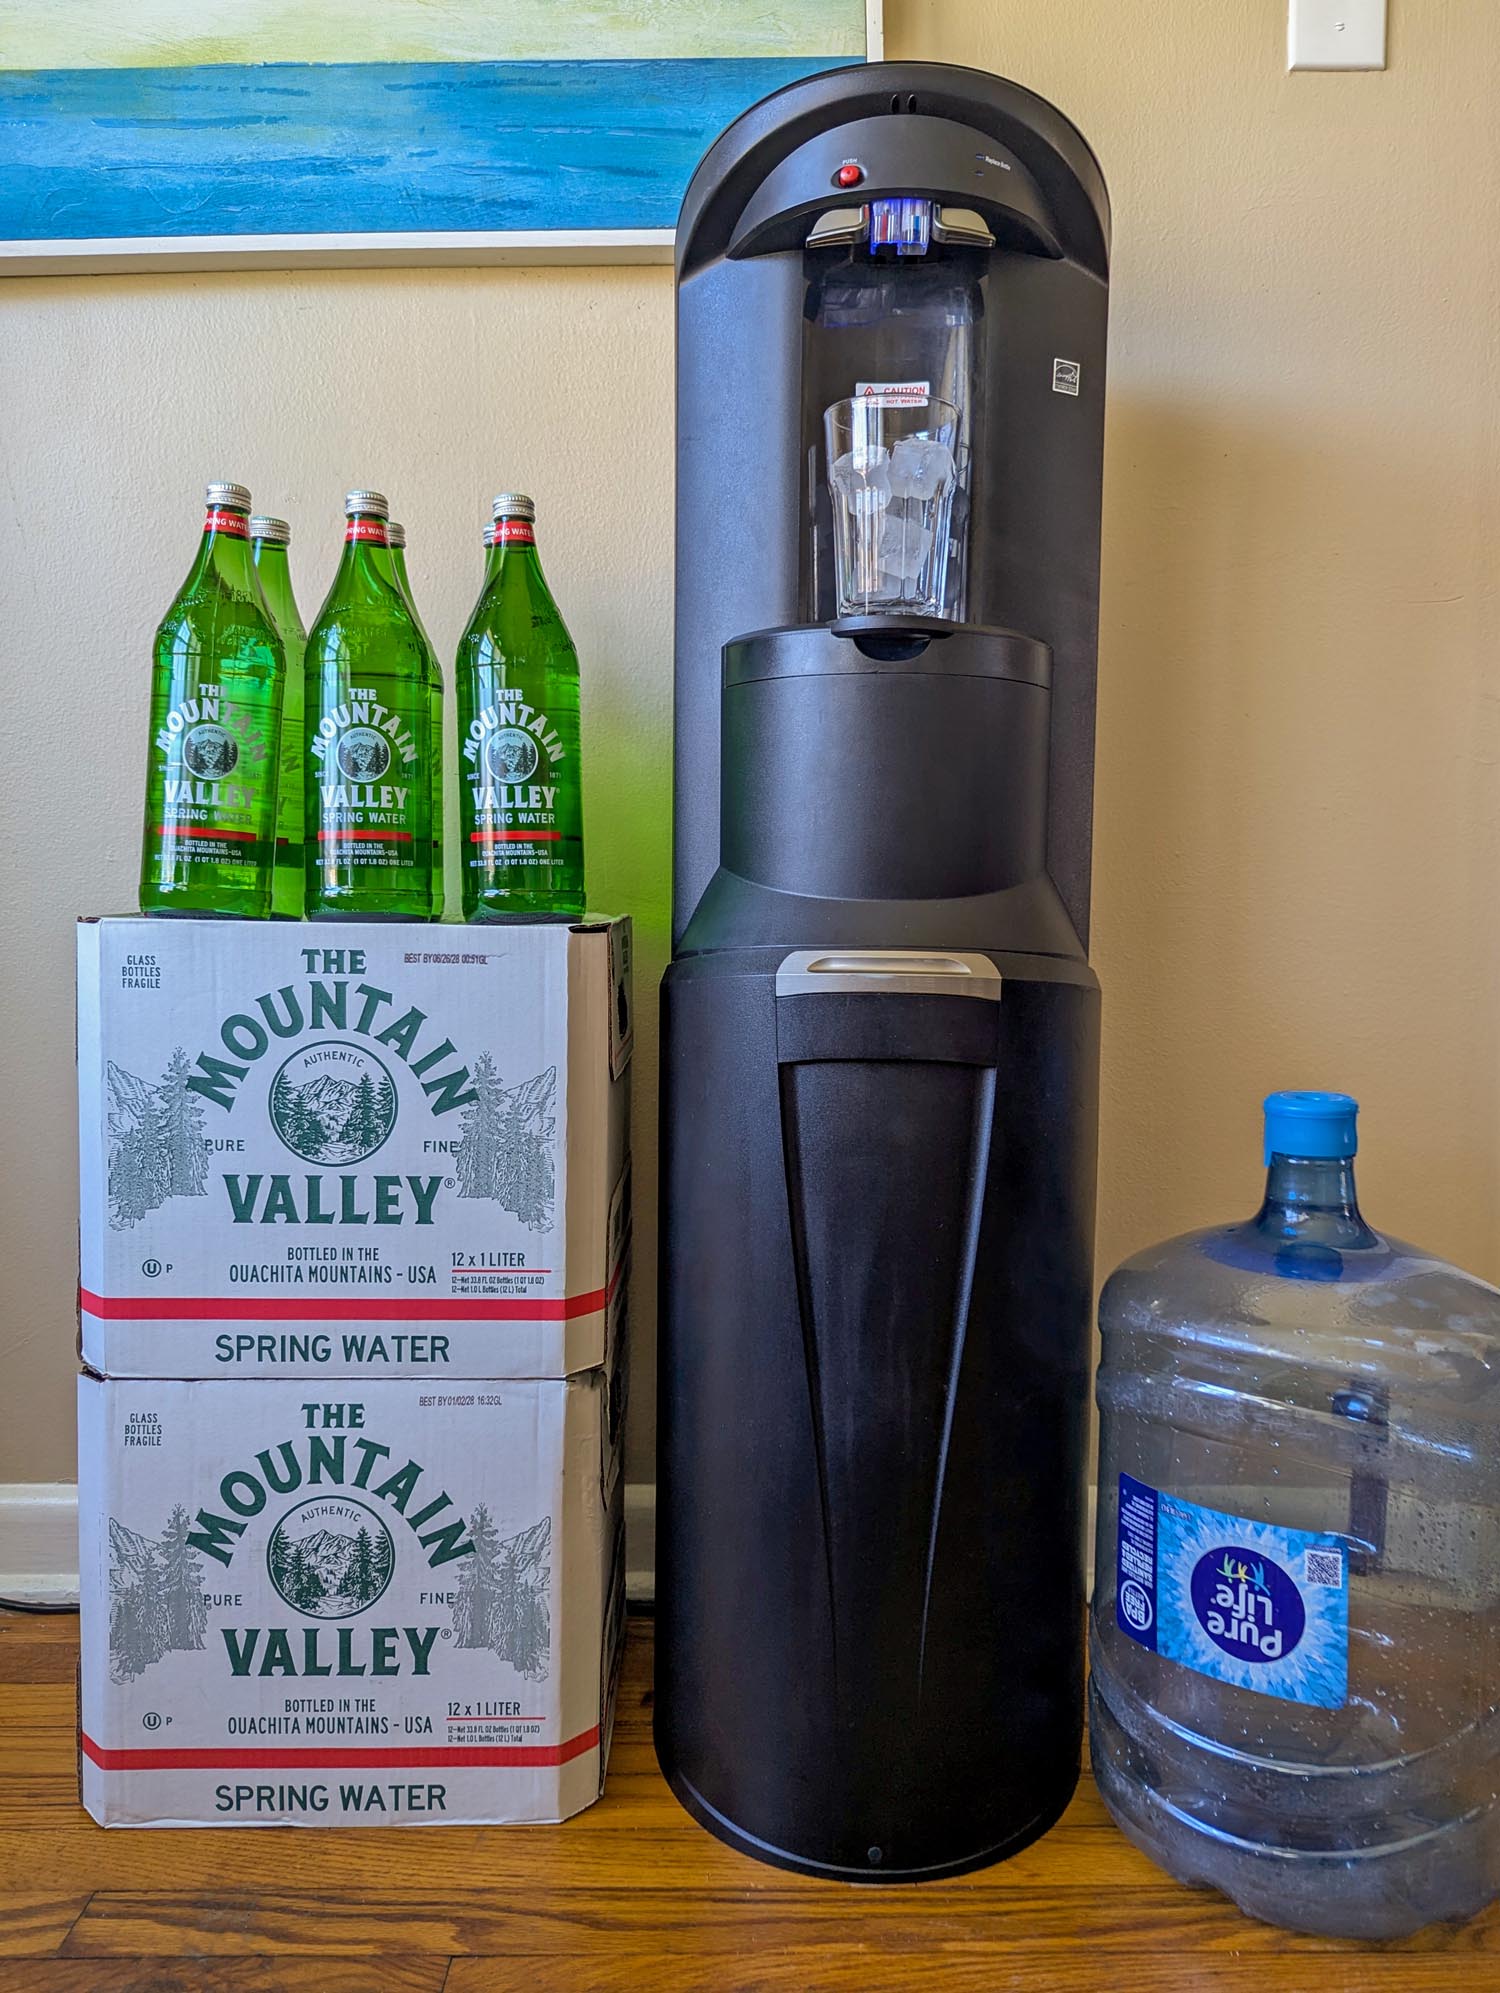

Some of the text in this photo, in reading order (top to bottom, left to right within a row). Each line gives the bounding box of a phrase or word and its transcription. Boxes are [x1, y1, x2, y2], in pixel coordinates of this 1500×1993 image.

[884, 386, 926, 395] CAUTION
[229, 519, 248, 530] WATE
[368, 528, 387, 537] WATE
[512, 528, 534, 537] WATE
[349, 688, 377, 700] THE
[496, 689, 523, 701] THE
[156, 697, 268, 762] MOUNTAIN
[311, 702, 418, 764] MOUNTAIN
[463, 703, 566, 763] MOUNTAIN
[164, 780, 256, 808] VALLEY
[320, 785, 408, 809] VALLEY
[472, 786, 556, 810] VALLEY
[164, 807, 252, 825] SPRING WATER
[323, 812, 406, 825] SPRING WATER
[474, 813, 555, 825] SPRING WATER
[127, 955, 156, 966] GLASS
[301, 949, 367, 974] THE
[404, 953, 421, 963] BEST
[122, 967, 161, 977] BOTTLES
[122, 978, 160, 988] FRAGILE
[185, 980, 480, 1116] MOUNTAIN
[304, 1051, 365, 1068] AUTHENTIC
[205, 1140, 458, 1153] PURE FINE
[222, 1174, 444, 1225] VALLEY
[287, 1247, 379, 1261] BOTTLED IN THE
[452, 1252, 525, 1266] 12 x 1 LITER
[166, 1264, 173, 1273] P
[230, 1264, 304, 1283] OUACHITA
[309, 1265, 392, 1284] MOUNTAINS
[408, 1266, 436, 1284] USA
[497, 1276, 513, 1284] Bottles
[215, 1335, 450, 1362] SPRING WATER
[419, 1396, 436, 1406] BEST
[477, 1395, 502, 1406] 16:32GL
[130, 1413, 158, 1423] GLASS
[301, 1403, 366, 1428] THE
[124, 1425, 162, 1434] BOTTLES
[124, 1436, 162, 1446] FRAGILE
[185, 1436, 476, 1569] MOUNTAIN
[301, 1506, 362, 1523] AUTHENTIC
[203, 1593, 454, 1606] PURE FINE
[1125, 1591, 1145, 1611] FREE
[1216, 1583, 1272, 1626] Life
[1125, 1601, 1145, 1625] BPA
[1207, 1610, 1282, 1657] Pure
[220, 1626, 441, 1677] VALLEY
[285, 1699, 376, 1713] BOTTLED IN THE
[448, 1702, 520, 1716] 12 x 1 LITER
[166, 1717, 172, 1726] P
[228, 1716, 300, 1734] OUACHITA
[306, 1716, 389, 1734] MOUNTAINS
[405, 1716, 433, 1734] USA
[493, 1725, 509, 1733] Bottles
[215, 1784, 447, 1812] SPRING WATER
